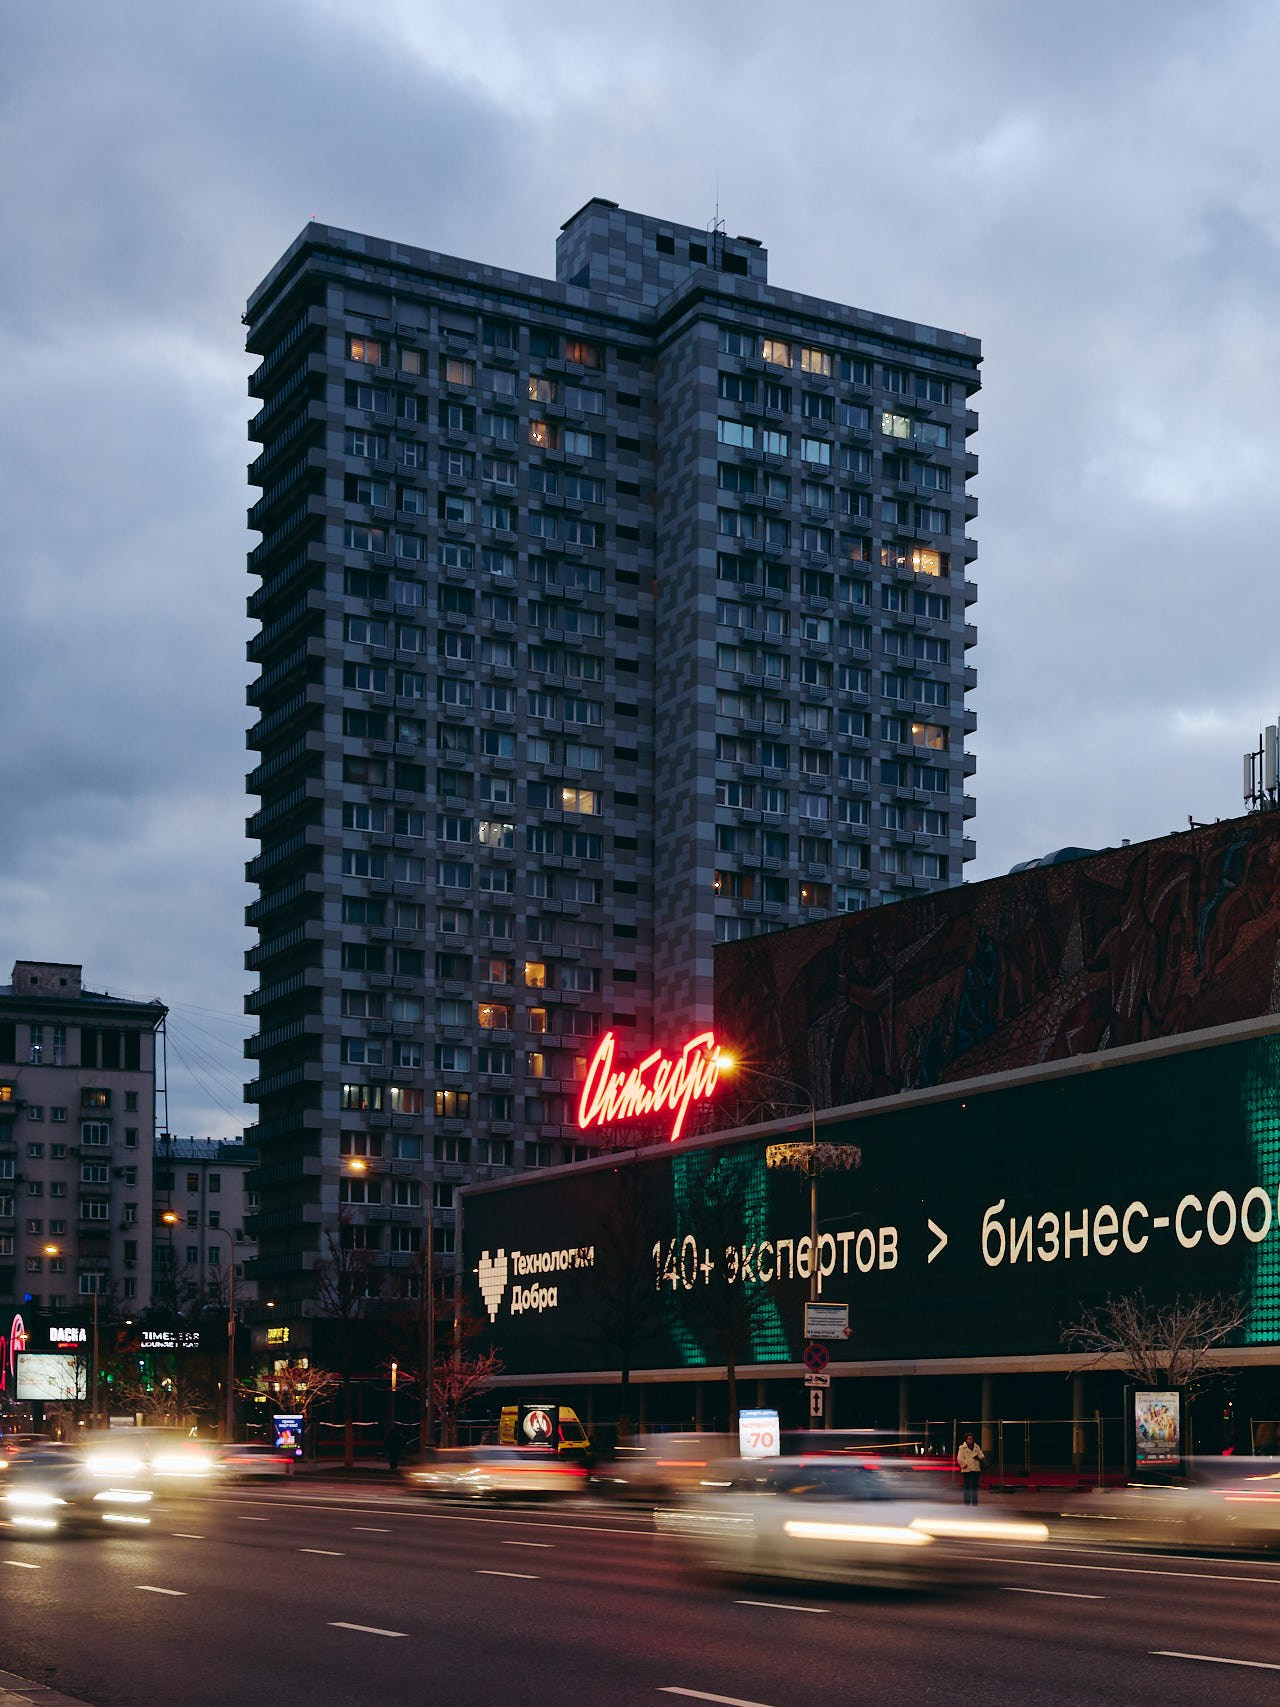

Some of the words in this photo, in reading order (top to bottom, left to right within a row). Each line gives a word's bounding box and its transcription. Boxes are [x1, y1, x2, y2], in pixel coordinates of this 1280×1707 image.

[511, 1246, 595, 1276] Технологии
[652, 1234, 715, 1291] 140+
[722, 1226, 898, 1294] экспертов
[510, 1282, 558, 1316] Добра
[746, 1432, 774, 1449] -70
